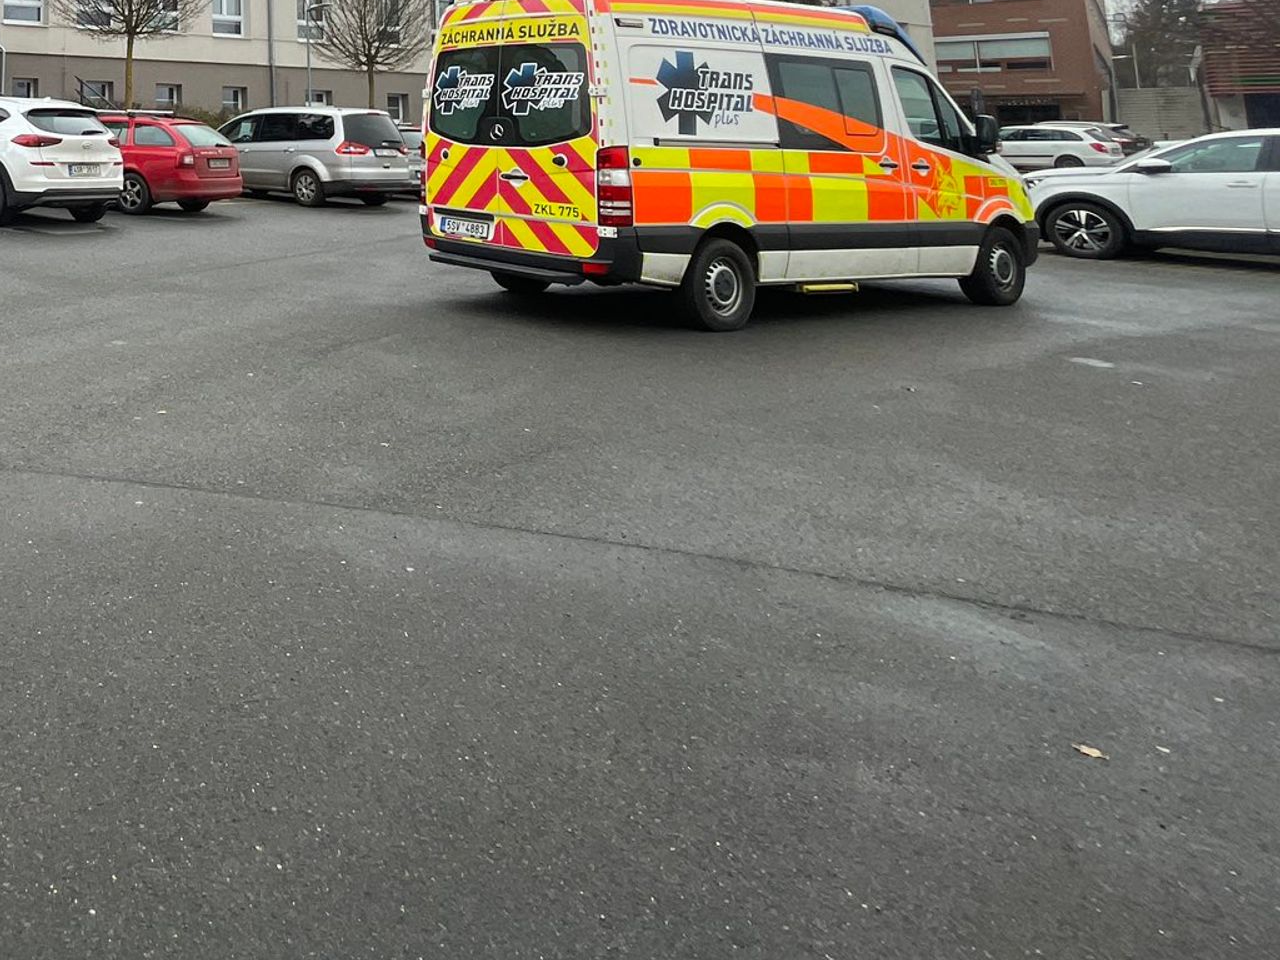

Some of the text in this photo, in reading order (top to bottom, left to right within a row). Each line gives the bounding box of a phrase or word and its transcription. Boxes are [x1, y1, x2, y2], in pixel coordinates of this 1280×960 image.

[441, 20, 580, 45] ZÁCHRANNÁ SLUŽBA
[648, 18, 893, 55] ZDRAVOTNICKÁ ZÁCHRANNÁ SLUŽBA
[714, 109, 739, 128] plus
[534, 204, 579, 218] ZKL 775
[446, 220, 460, 232] 5SV
